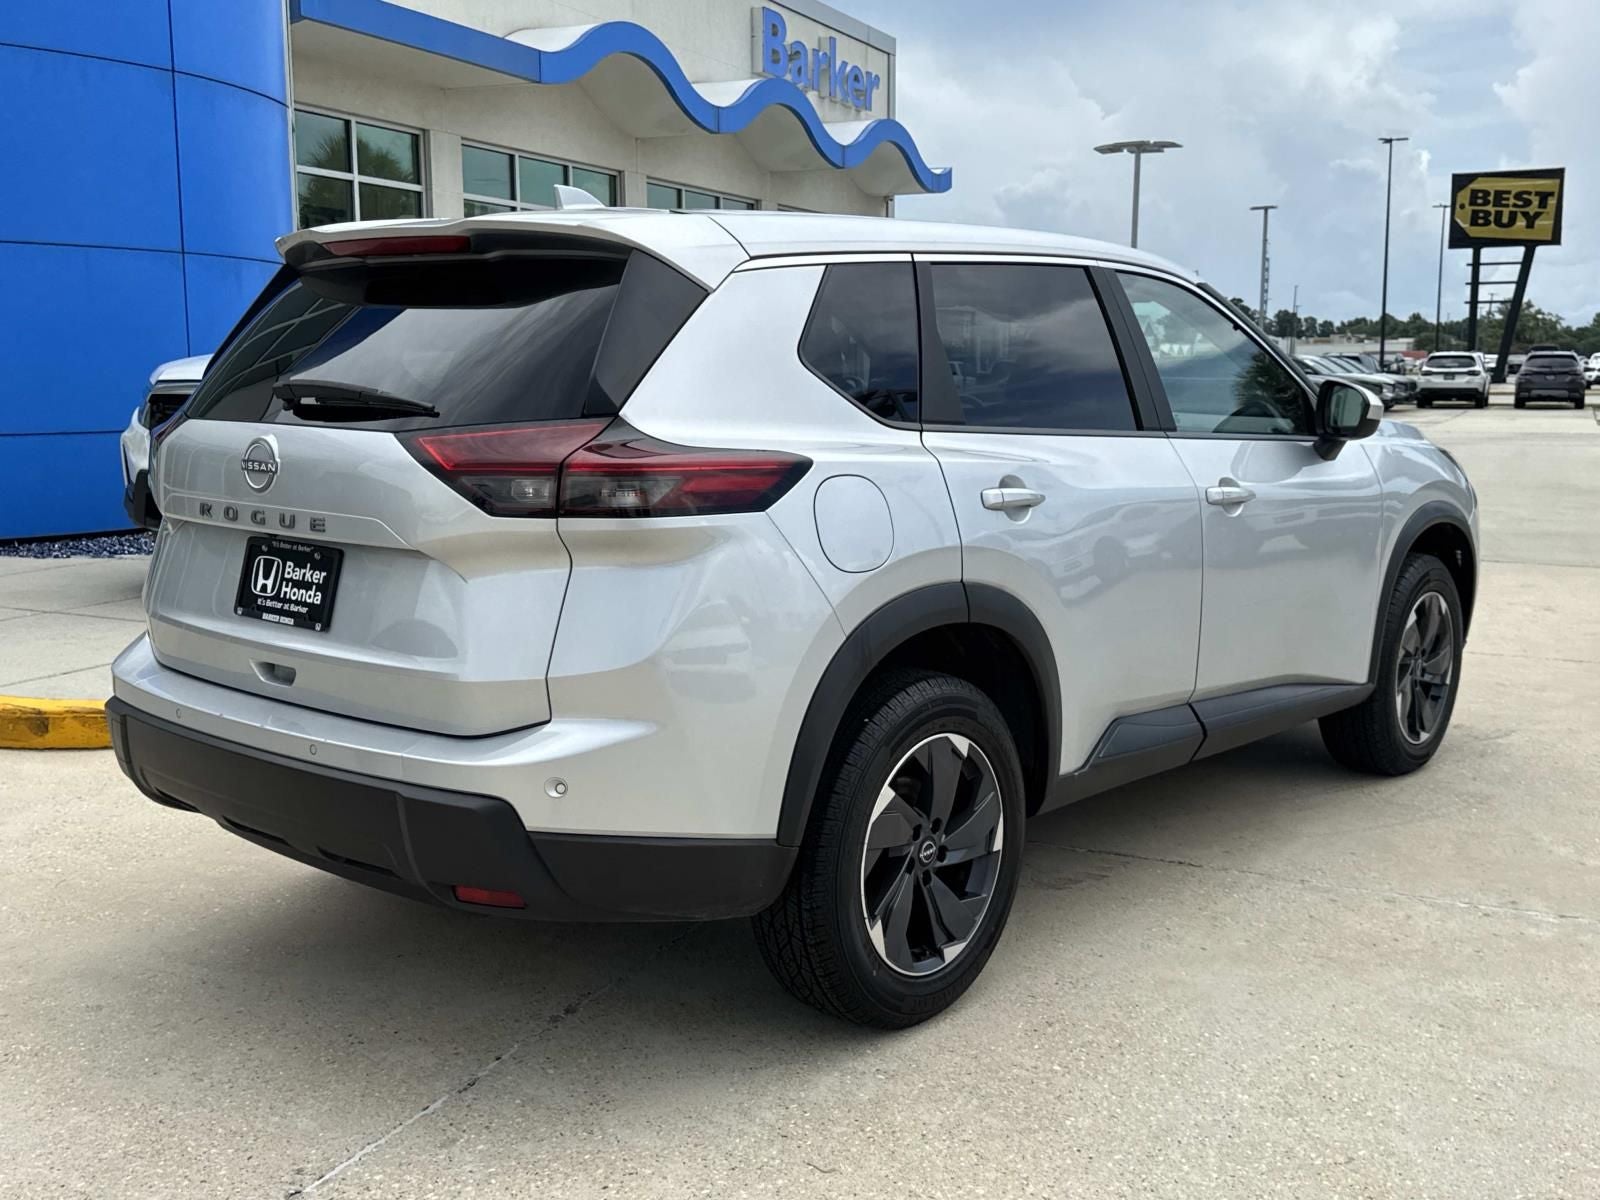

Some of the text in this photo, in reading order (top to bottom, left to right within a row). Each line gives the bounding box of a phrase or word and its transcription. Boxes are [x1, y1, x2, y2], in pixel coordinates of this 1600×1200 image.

[763, 6, 880, 112] Barker
[1468, 188, 1555, 209] BEST
[1469, 209, 1545, 229] BUY
[241, 459, 276, 472] NISSAN
[199, 502, 326, 533] ROGUE
[284, 561, 327, 584] Barker
[280, 581, 322, 605] Honda
